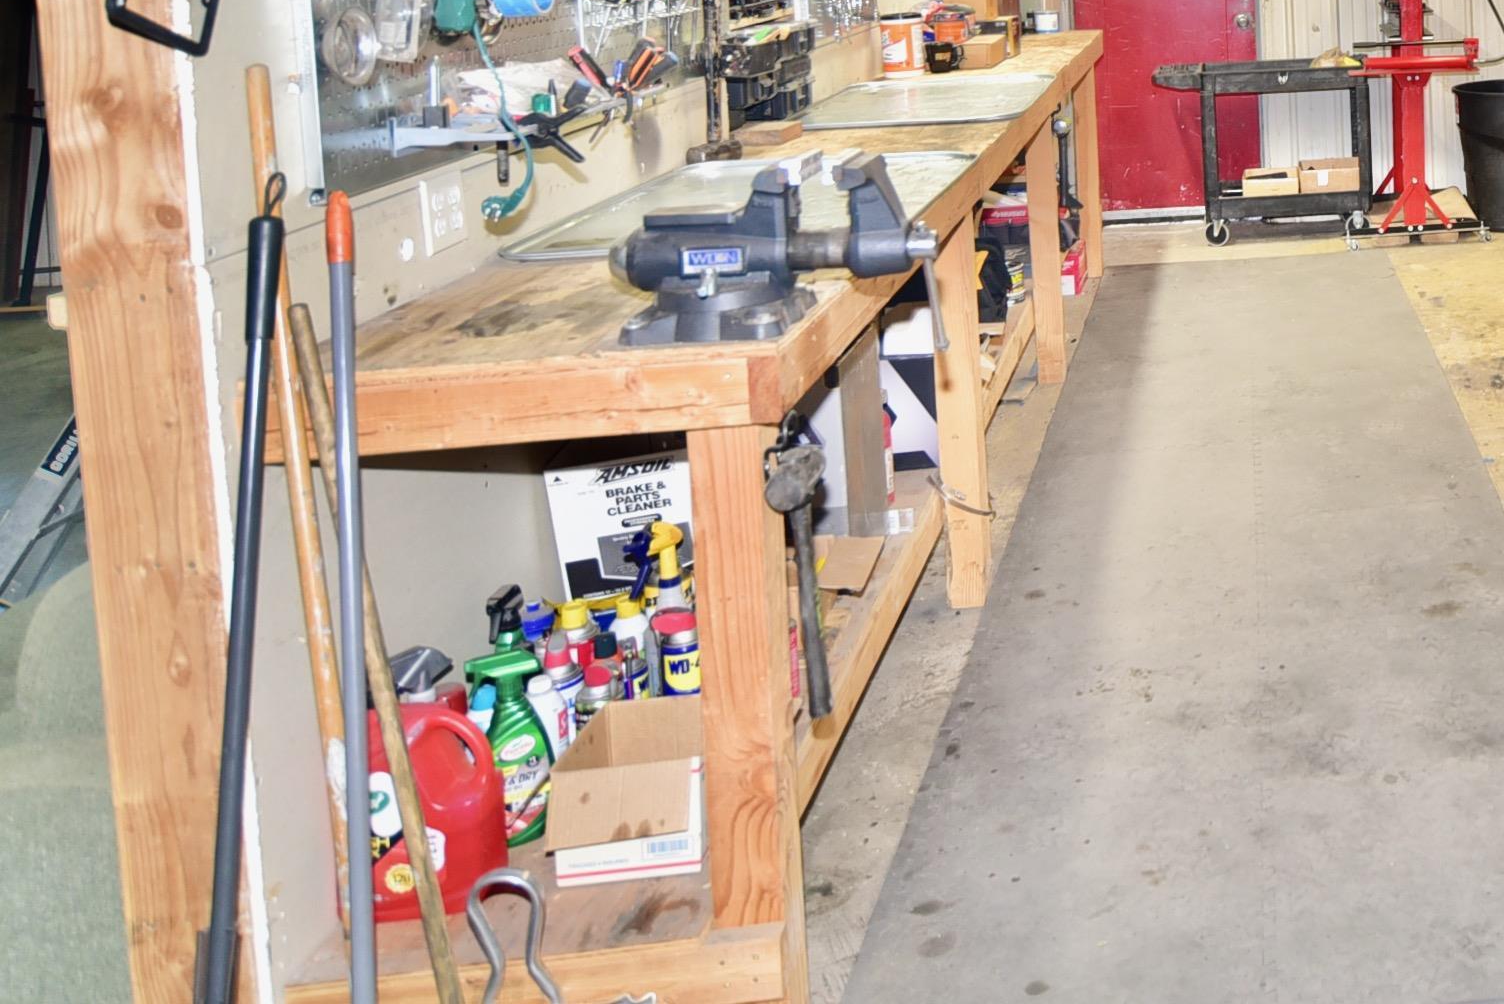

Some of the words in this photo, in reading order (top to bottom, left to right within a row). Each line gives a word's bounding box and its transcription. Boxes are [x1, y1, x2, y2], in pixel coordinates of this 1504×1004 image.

[595, 458, 672, 483] AMSOIL
[605, 482, 654, 498] BRAKE
[656, 480, 666, 489] &
[615, 490, 661, 505] PARTS
[607, 498, 672, 516] CLEANER
